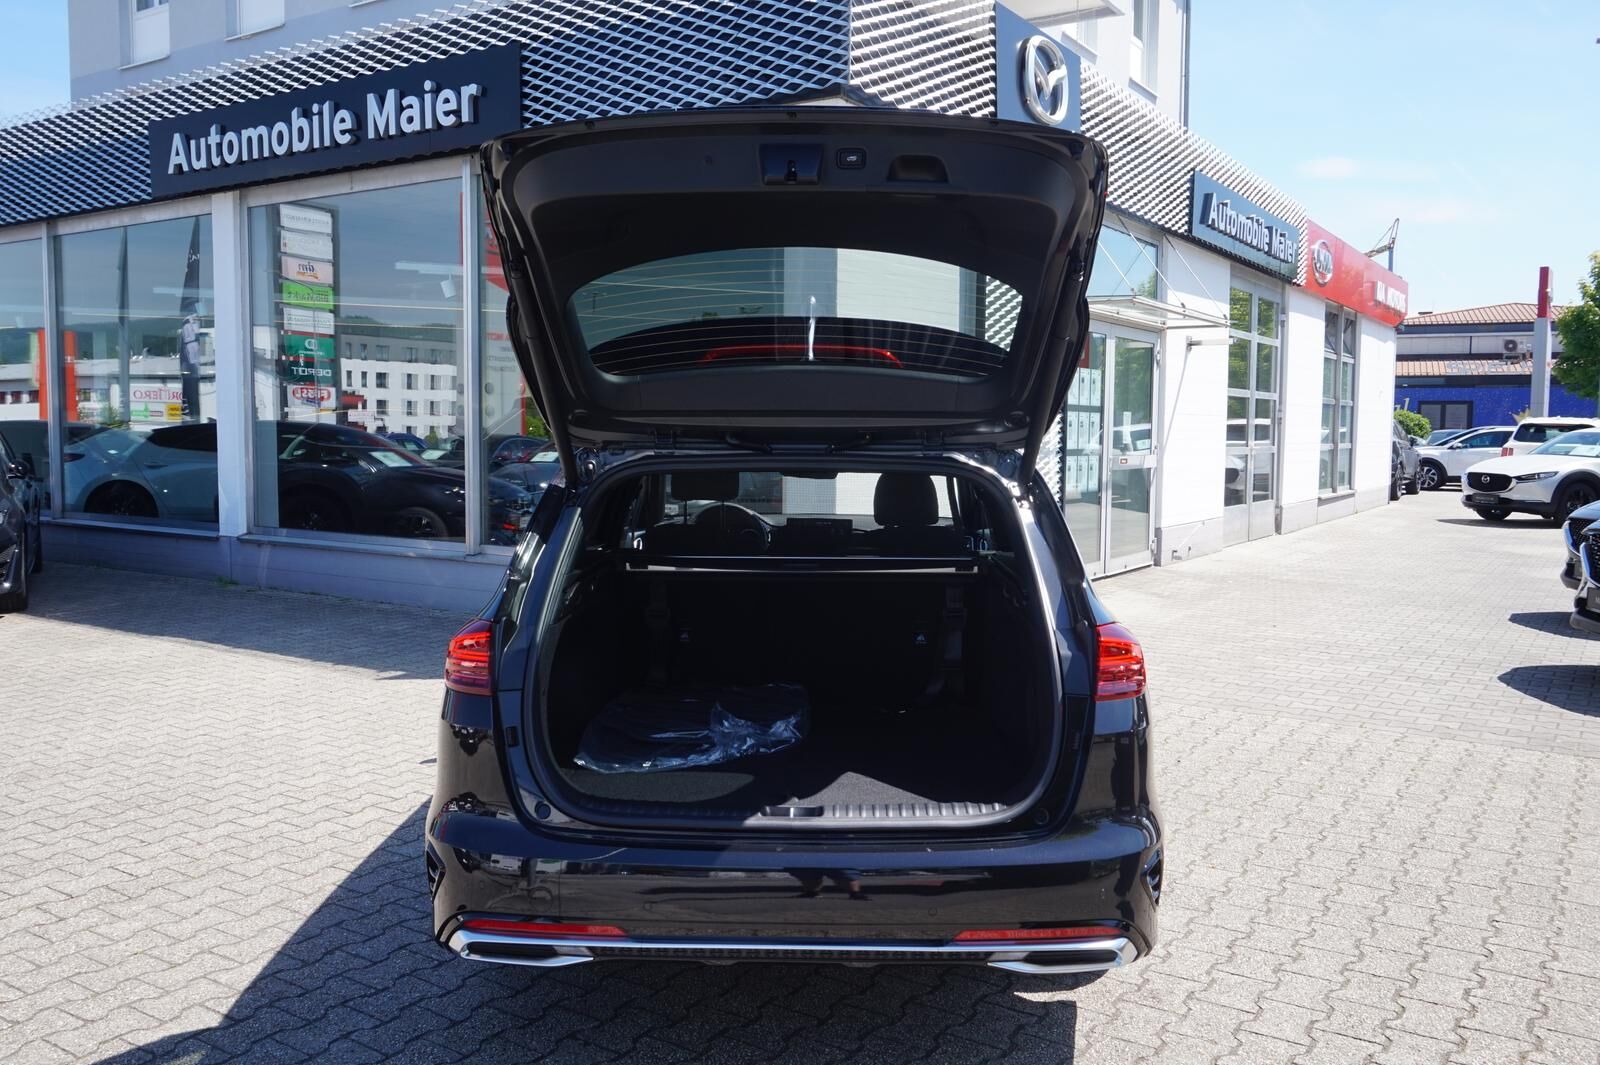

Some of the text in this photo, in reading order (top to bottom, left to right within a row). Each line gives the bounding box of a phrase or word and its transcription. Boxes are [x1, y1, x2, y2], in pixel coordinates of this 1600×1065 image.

[168, 80, 483, 175] Automobile Maier
[1206, 192, 1298, 264] Automobile Maier
